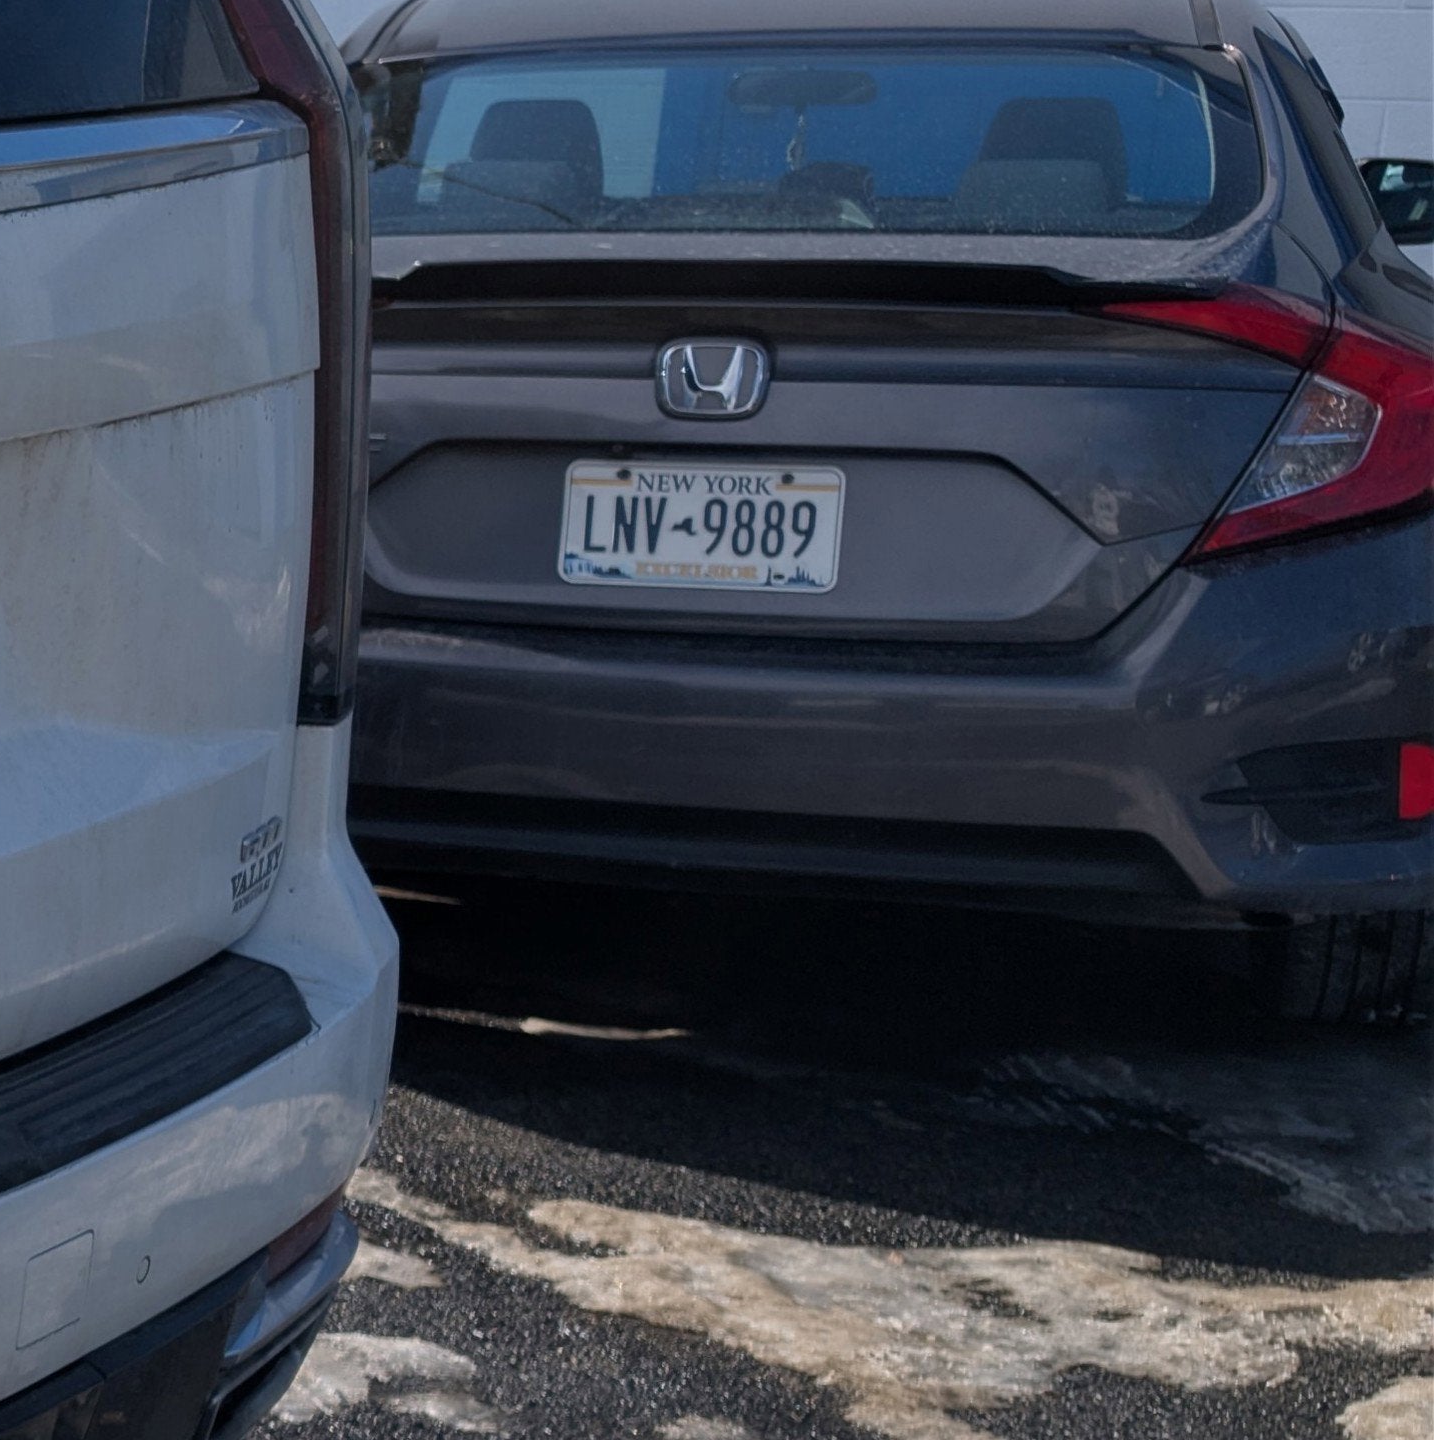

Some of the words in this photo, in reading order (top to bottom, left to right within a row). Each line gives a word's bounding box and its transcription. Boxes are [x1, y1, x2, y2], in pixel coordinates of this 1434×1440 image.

[636, 472, 696, 494] NEW
[703, 474, 773, 496] YORK
[583, 494, 668, 555] LNV
[702, 497, 818, 559] 9889
[230, 841, 283, 901] VALLEY
